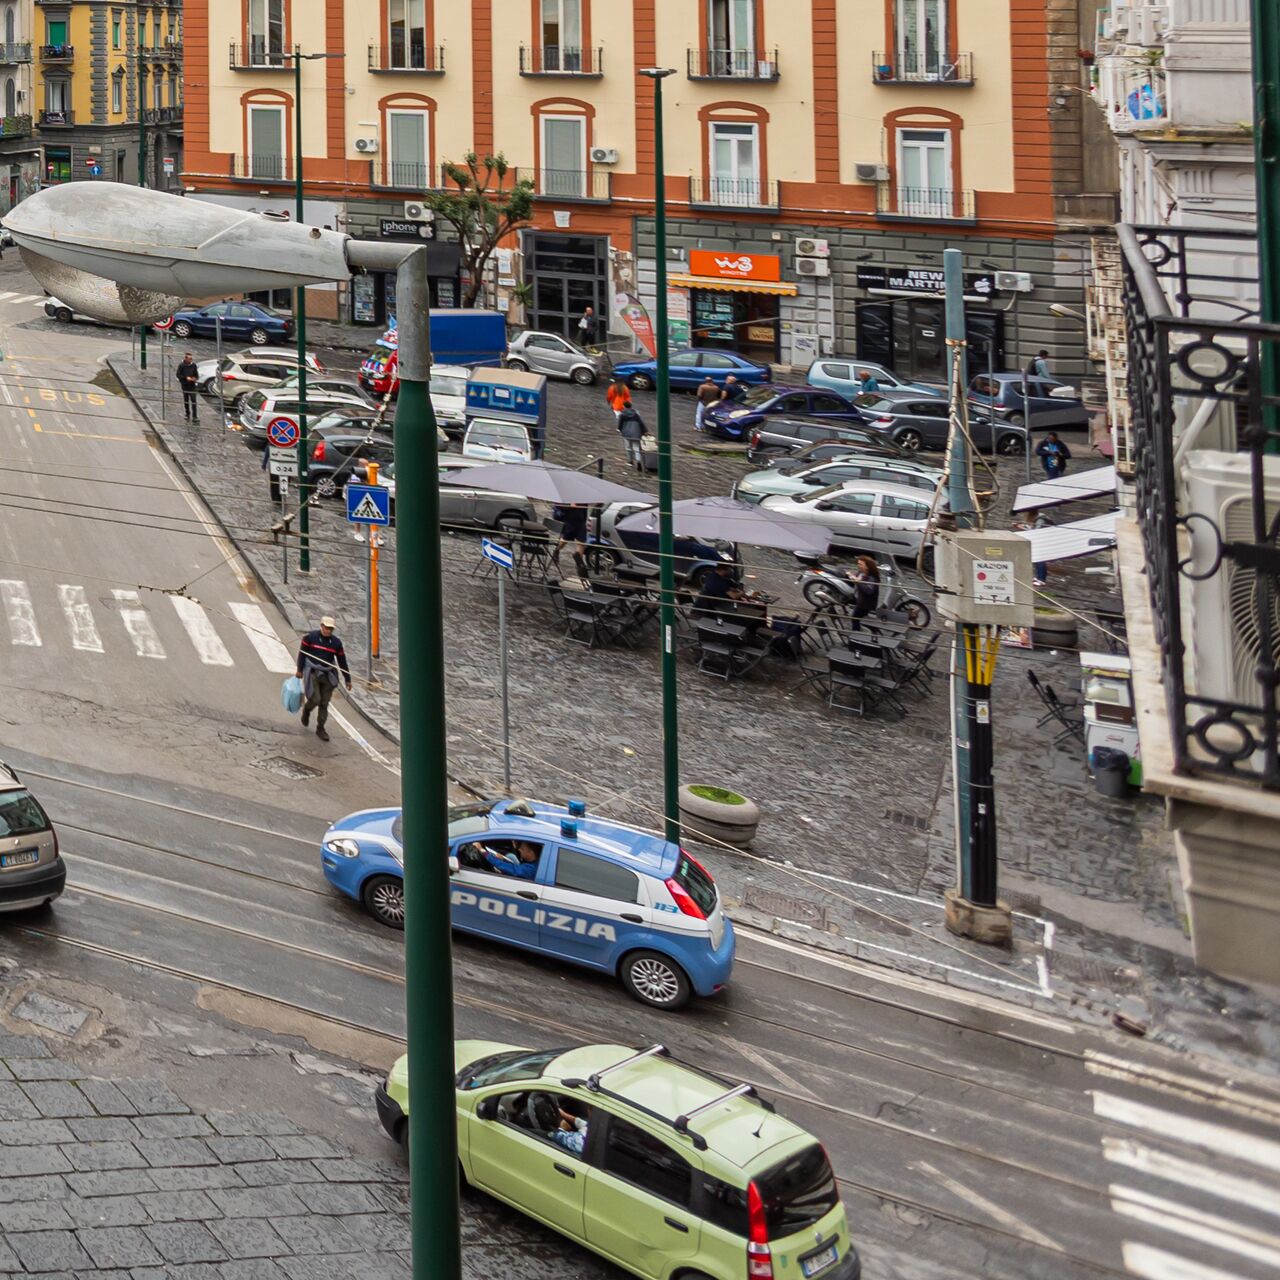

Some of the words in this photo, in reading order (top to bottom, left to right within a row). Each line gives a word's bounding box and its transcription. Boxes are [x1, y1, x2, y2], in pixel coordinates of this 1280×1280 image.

[382, 222, 418, 233] iphone
[908, 271, 944, 282] NEW
[39, 388, 105, 406] BUS
[654, 901, 679, 914] 113
[451, 890, 617, 943] POLIZIA
